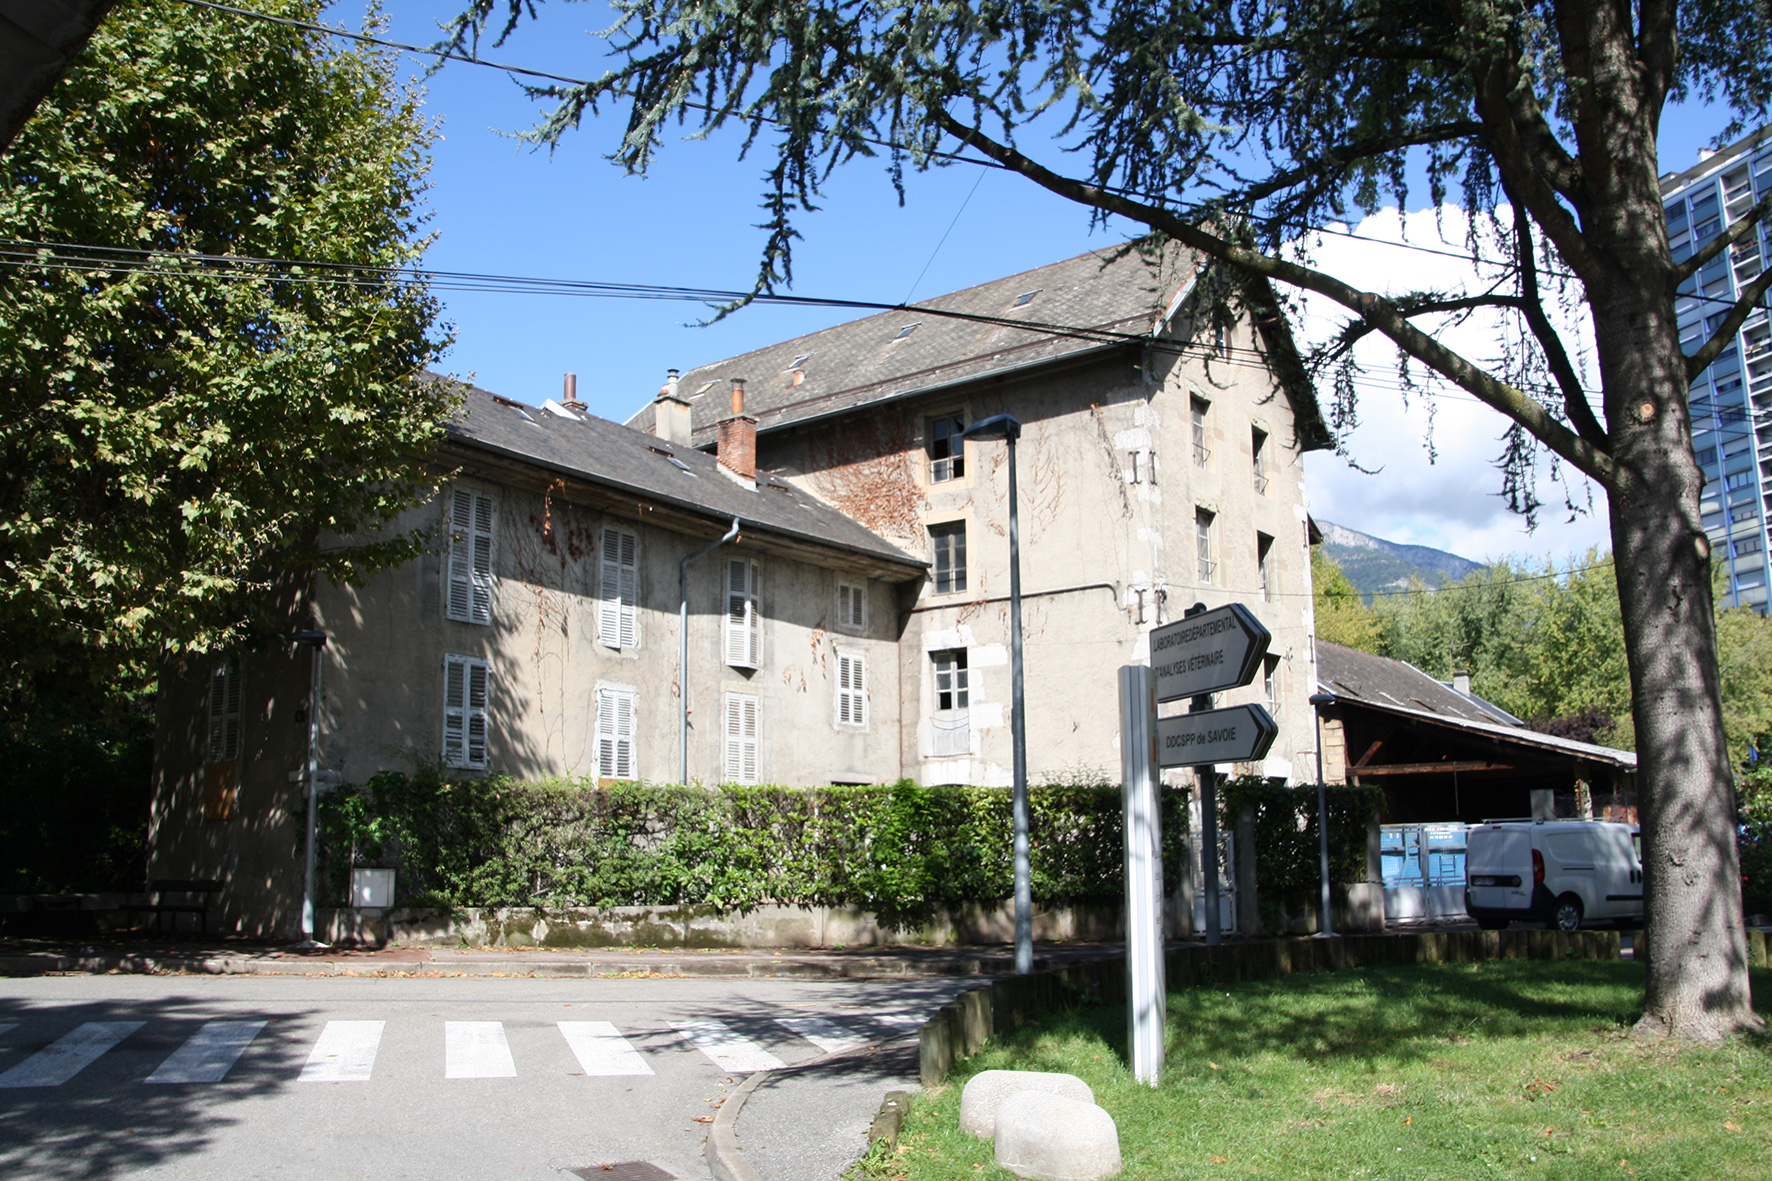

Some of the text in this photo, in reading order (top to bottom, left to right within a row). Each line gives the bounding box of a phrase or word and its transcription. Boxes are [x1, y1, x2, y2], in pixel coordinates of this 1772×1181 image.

[1187, 650, 1224, 672] VÉTÉRINAIRE
[1166, 727, 1236, 748] DDCSPP de SAVOIE
